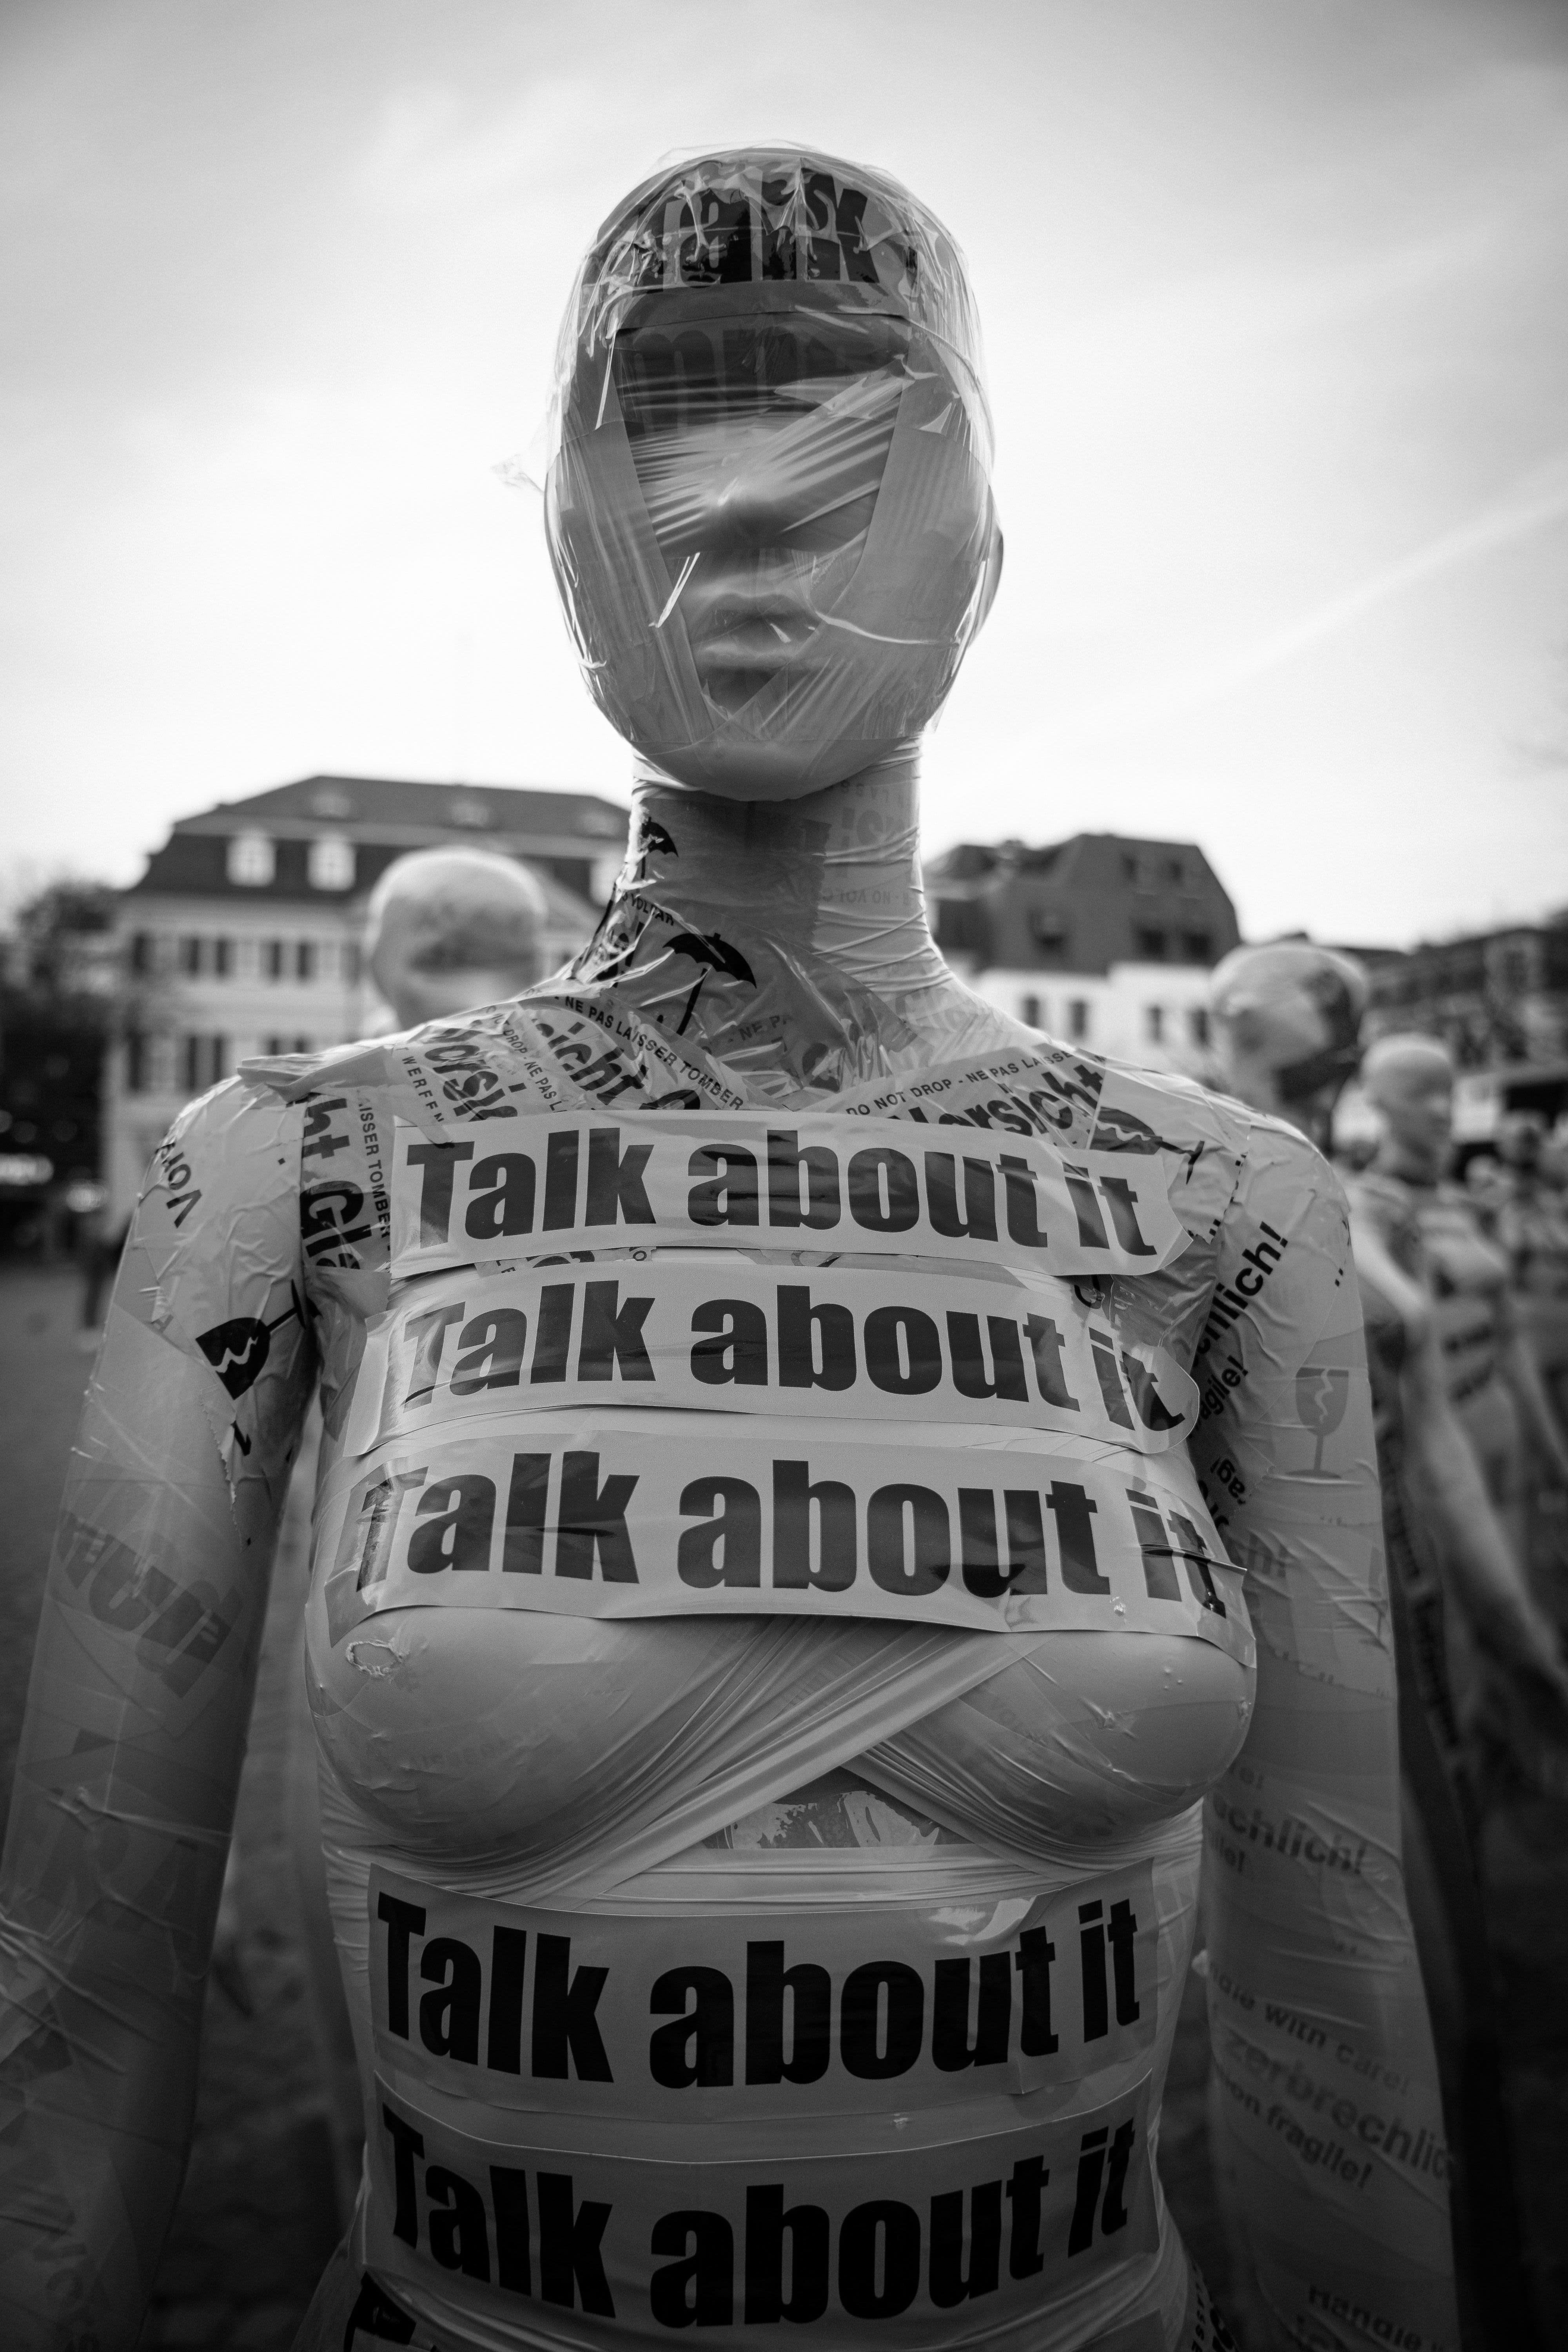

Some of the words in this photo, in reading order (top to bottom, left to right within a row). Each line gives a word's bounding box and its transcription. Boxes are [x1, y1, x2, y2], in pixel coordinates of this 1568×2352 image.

[502, 1029, 528, 1055] DROP
[524, 1060, 544, 1078] NE
[536, 1076, 557, 1100] PAS
[564, 996, 584, 1014] NE
[589, 1004, 614, 1028] PAS
[615, 1020, 678, 1066] LAISSER
[679, 1061, 744, 1110] TOMBER
[874, 1092, 907, 1111] NOT
[910, 1078, 952, 1098] DROP
[967, 1069, 990, 1083] NE
[990, 1062, 1020, 1078] PAS
[407, 1128, 656, 1249] Talk
[687, 1129, 1049, 1249] about
[1063, 1161, 1157, 1256] it
[404, 1280, 657, 1414] Talk
[691, 1285, 1080, 1413] about
[1088, 1327, 1185, 1432] it
[356, 1450, 641, 1593] Talk
[677, 1459, 1111, 1598] about
[1124, 1487, 1228, 1620] it
[377, 1891, 615, 2084] Talk
[648, 1926, 1059, 2090] about
[1078, 1898, 1140, 2044] it
[381, 2102, 616, 2319] Talk
[650, 2156, 1050, 2330] about
[1068, 2118, 1135, 2259] it
